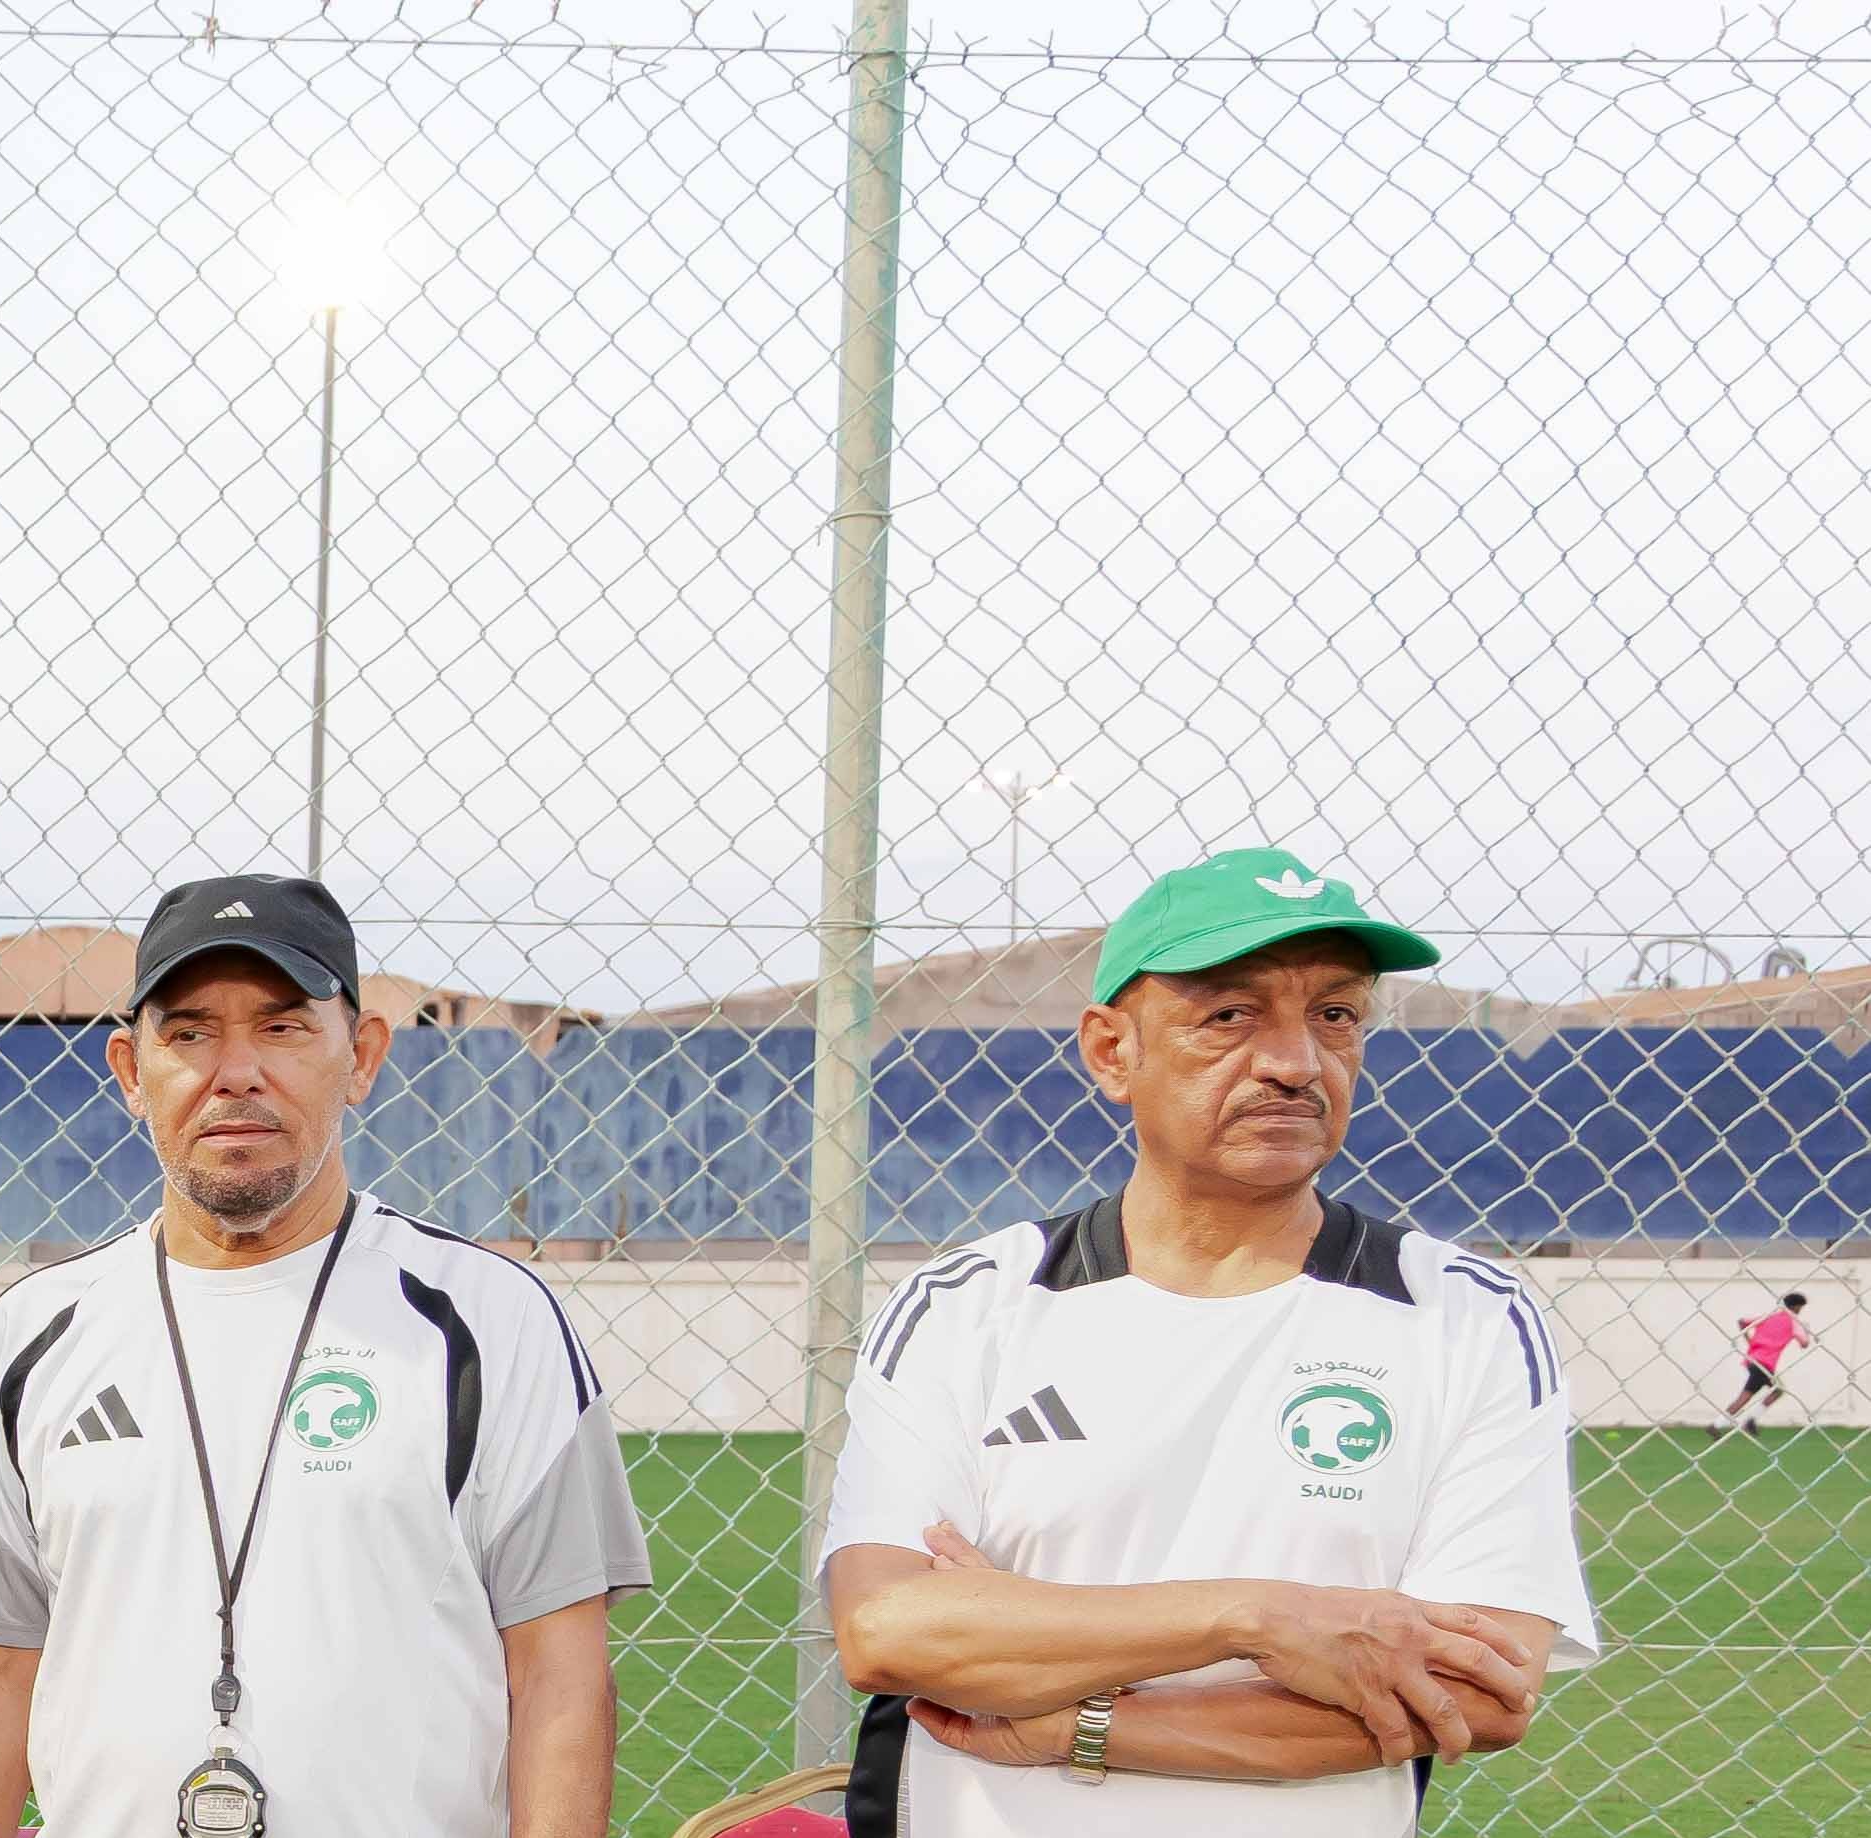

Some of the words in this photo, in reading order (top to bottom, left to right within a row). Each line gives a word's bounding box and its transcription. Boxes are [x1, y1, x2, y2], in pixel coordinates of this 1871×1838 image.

[1293, 1361, 1388, 1380] السعودية
[333, 1417, 362, 1426] SAFF
[1339, 1436, 1374, 1447] SAFF
[303, 1460, 353, 1473] SAUDI
[1300, 1484, 1363, 1501] SAUDI
